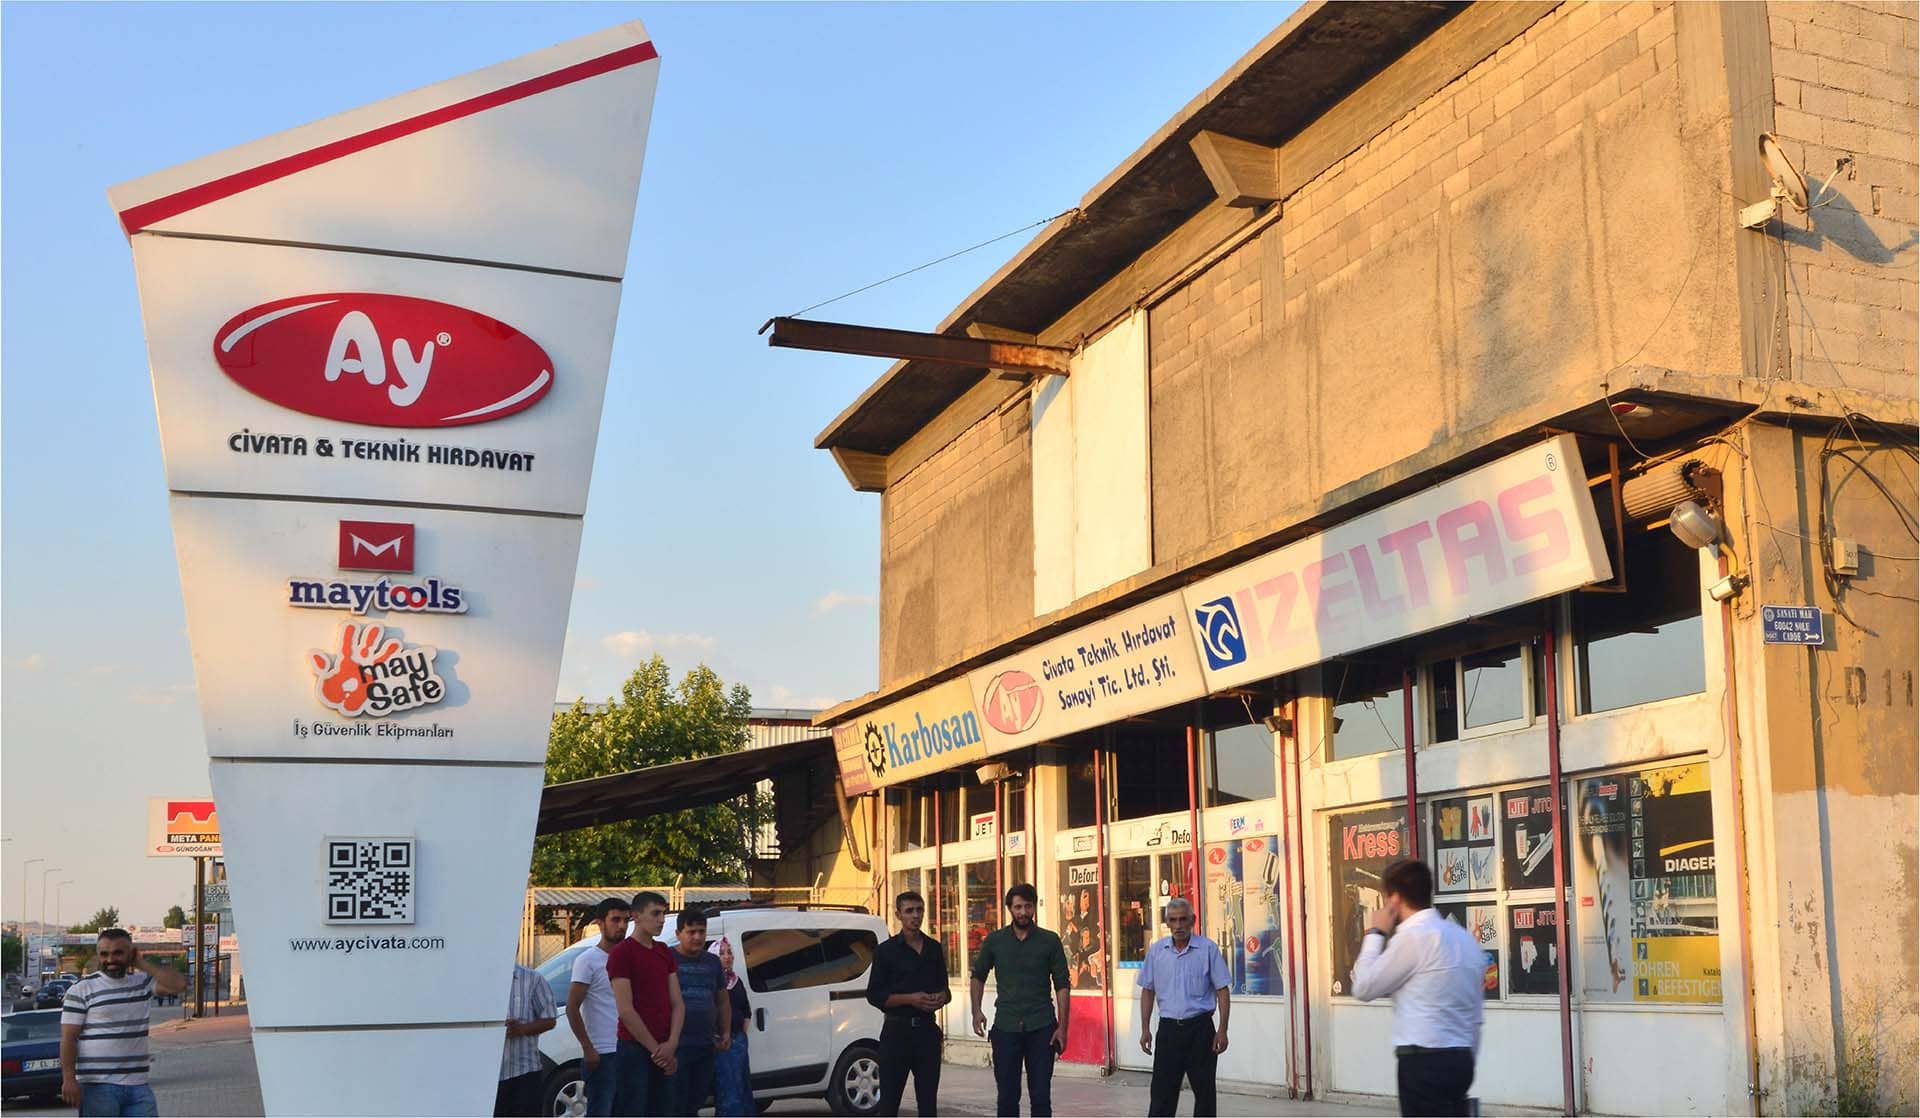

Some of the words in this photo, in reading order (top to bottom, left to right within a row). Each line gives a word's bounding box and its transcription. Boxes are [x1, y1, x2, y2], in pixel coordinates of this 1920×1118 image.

[228, 428, 309, 456] CİVATA
[315, 438, 335, 457] &
[341, 438, 421, 463] TEKNİK
[427, 446, 535, 472] HIRDAVAT
[289, 579, 462, 612] maytools
[1042, 656, 1075, 680] Civata
[1077, 637, 1120, 667] Teknik
[1121, 615, 1176, 652] Hırdavat
[359, 652, 429, 684] may
[1058, 680, 1097, 710] Sanayi
[1097, 675, 1122, 697] Tic.
[1124, 664, 1150, 690] Ltd.
[1152, 656, 1176, 686] Şti.
[366, 674, 442, 711] Safe
[294, 719, 309, 739] İş
[313, 722, 372, 737] Güvenlik
[377, 723, 454, 740] Ekipmanları
[883, 709, 981, 769] Karbosan
[170, 834, 197, 843] META
[976, 822, 993, 836] JET
[1171, 829, 1193, 845] Defo
[1343, 825, 1400, 860] Kress
[290, 936, 445, 953] www.aycivata.com
[1658, 978, 1721, 996] BEFESTIGE
